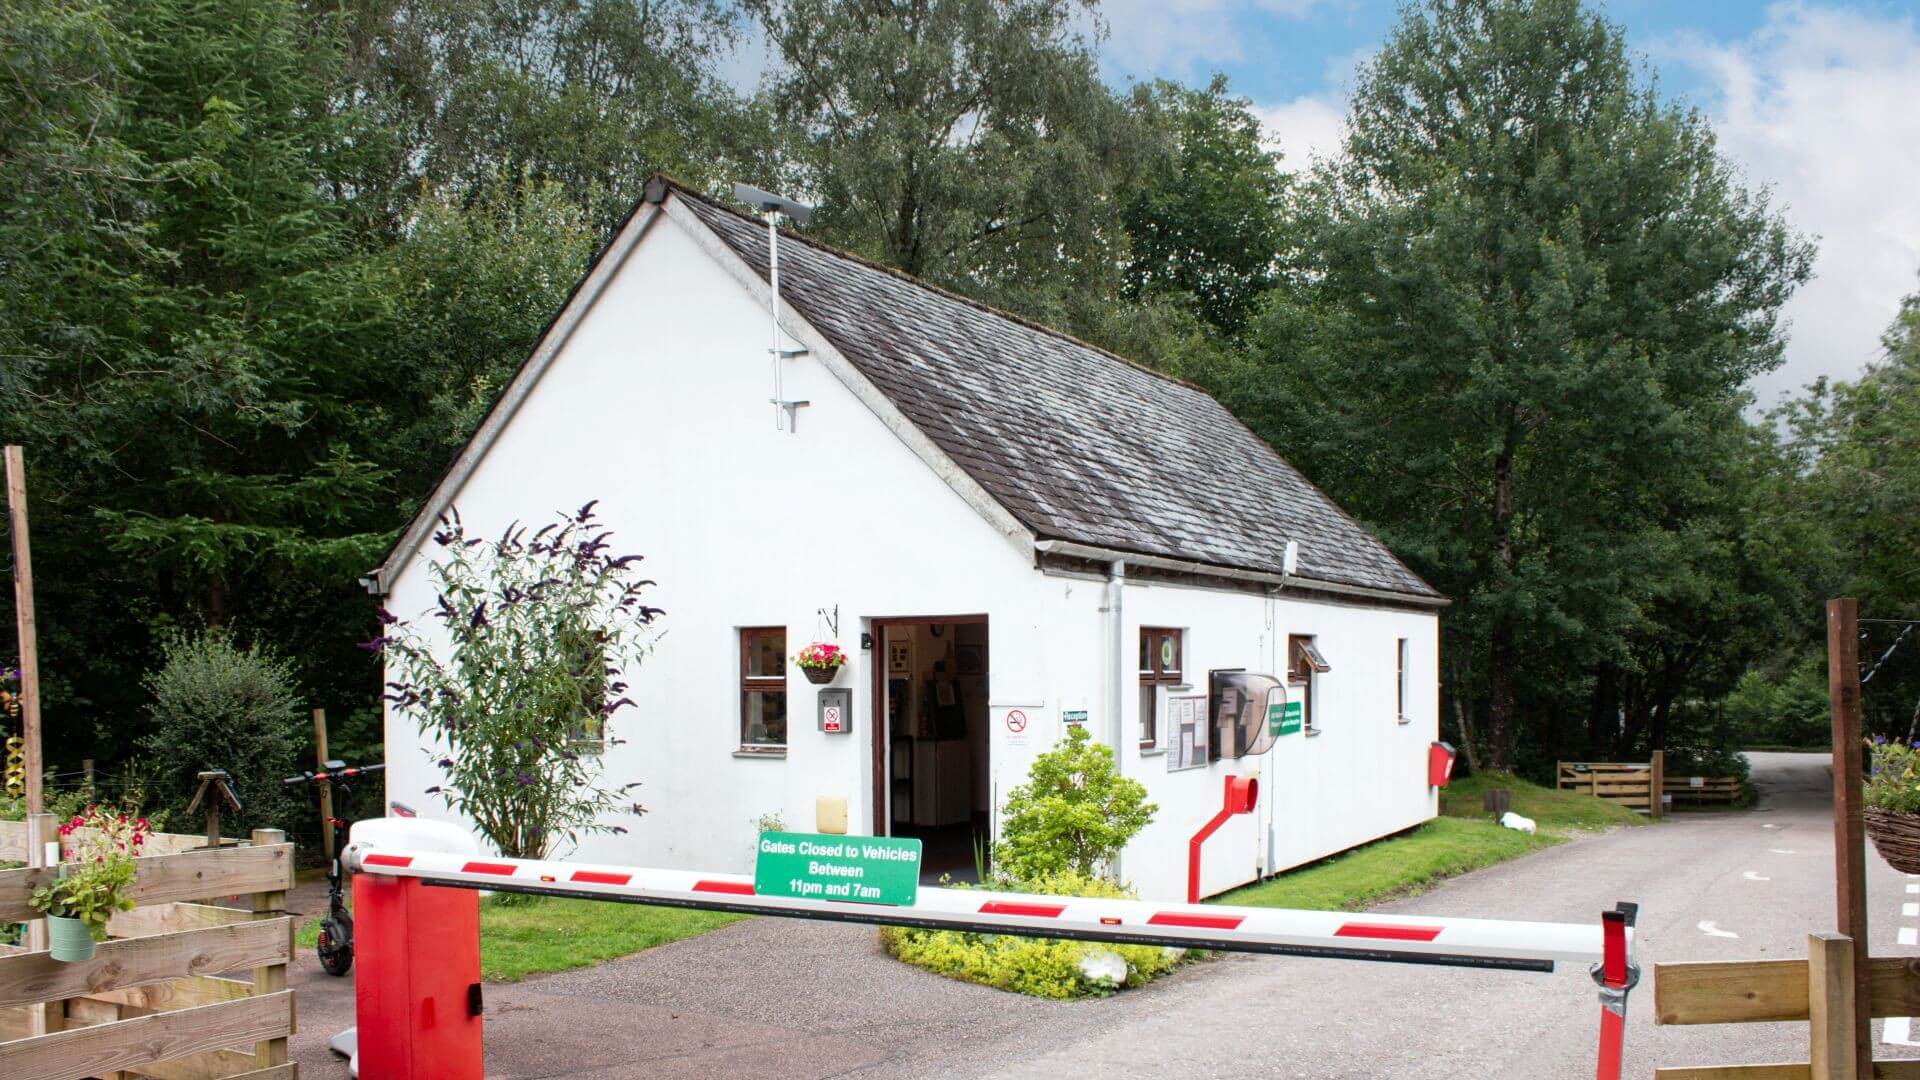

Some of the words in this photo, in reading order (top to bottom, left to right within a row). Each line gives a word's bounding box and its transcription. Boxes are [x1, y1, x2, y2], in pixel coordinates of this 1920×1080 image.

[761, 839, 796, 854] Gates
[799, 841, 842, 857] Closed
[846, 844, 858, 857] to
[862, 845, 917, 861] Vehicles
[809, 861, 863, 877] Between
[790, 879, 824, 896] 11pm
[826, 882, 849, 896] and
[853, 883, 881, 898] 7am
